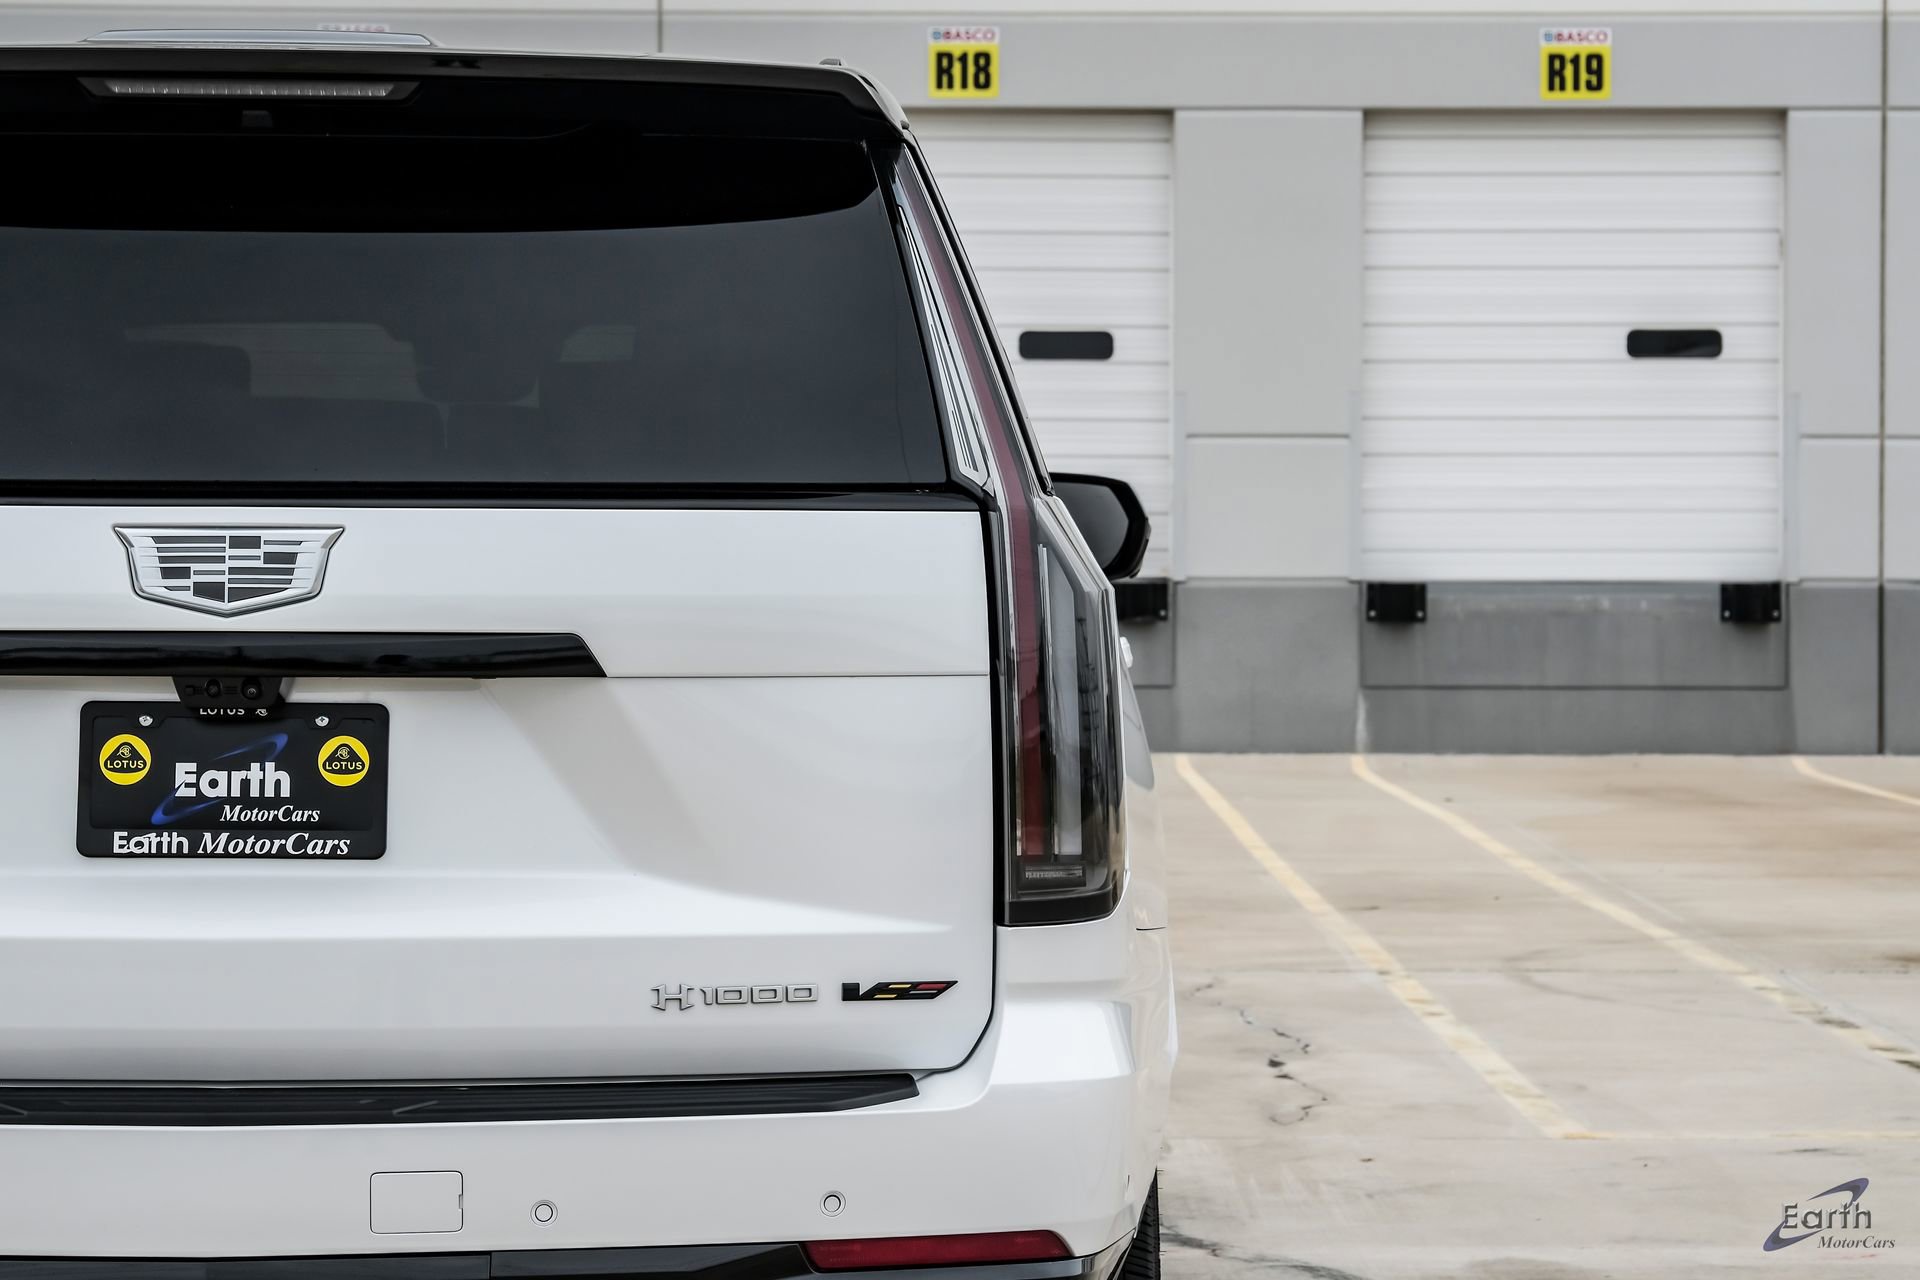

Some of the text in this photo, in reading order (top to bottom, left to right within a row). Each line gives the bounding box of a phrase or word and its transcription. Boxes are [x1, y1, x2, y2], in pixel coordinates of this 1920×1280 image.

[936, 52, 991, 89] R18
[1548, 53, 1604, 91] R19
[107, 760, 144, 769] LOTUS
[326, 761, 363, 770] LOTUS
[174, 762, 290, 797] Earth
[220, 805, 320, 821] MotorCars
[113, 832, 350, 855] Earth MotorCars
[650, 983, 818, 1011] H1000
